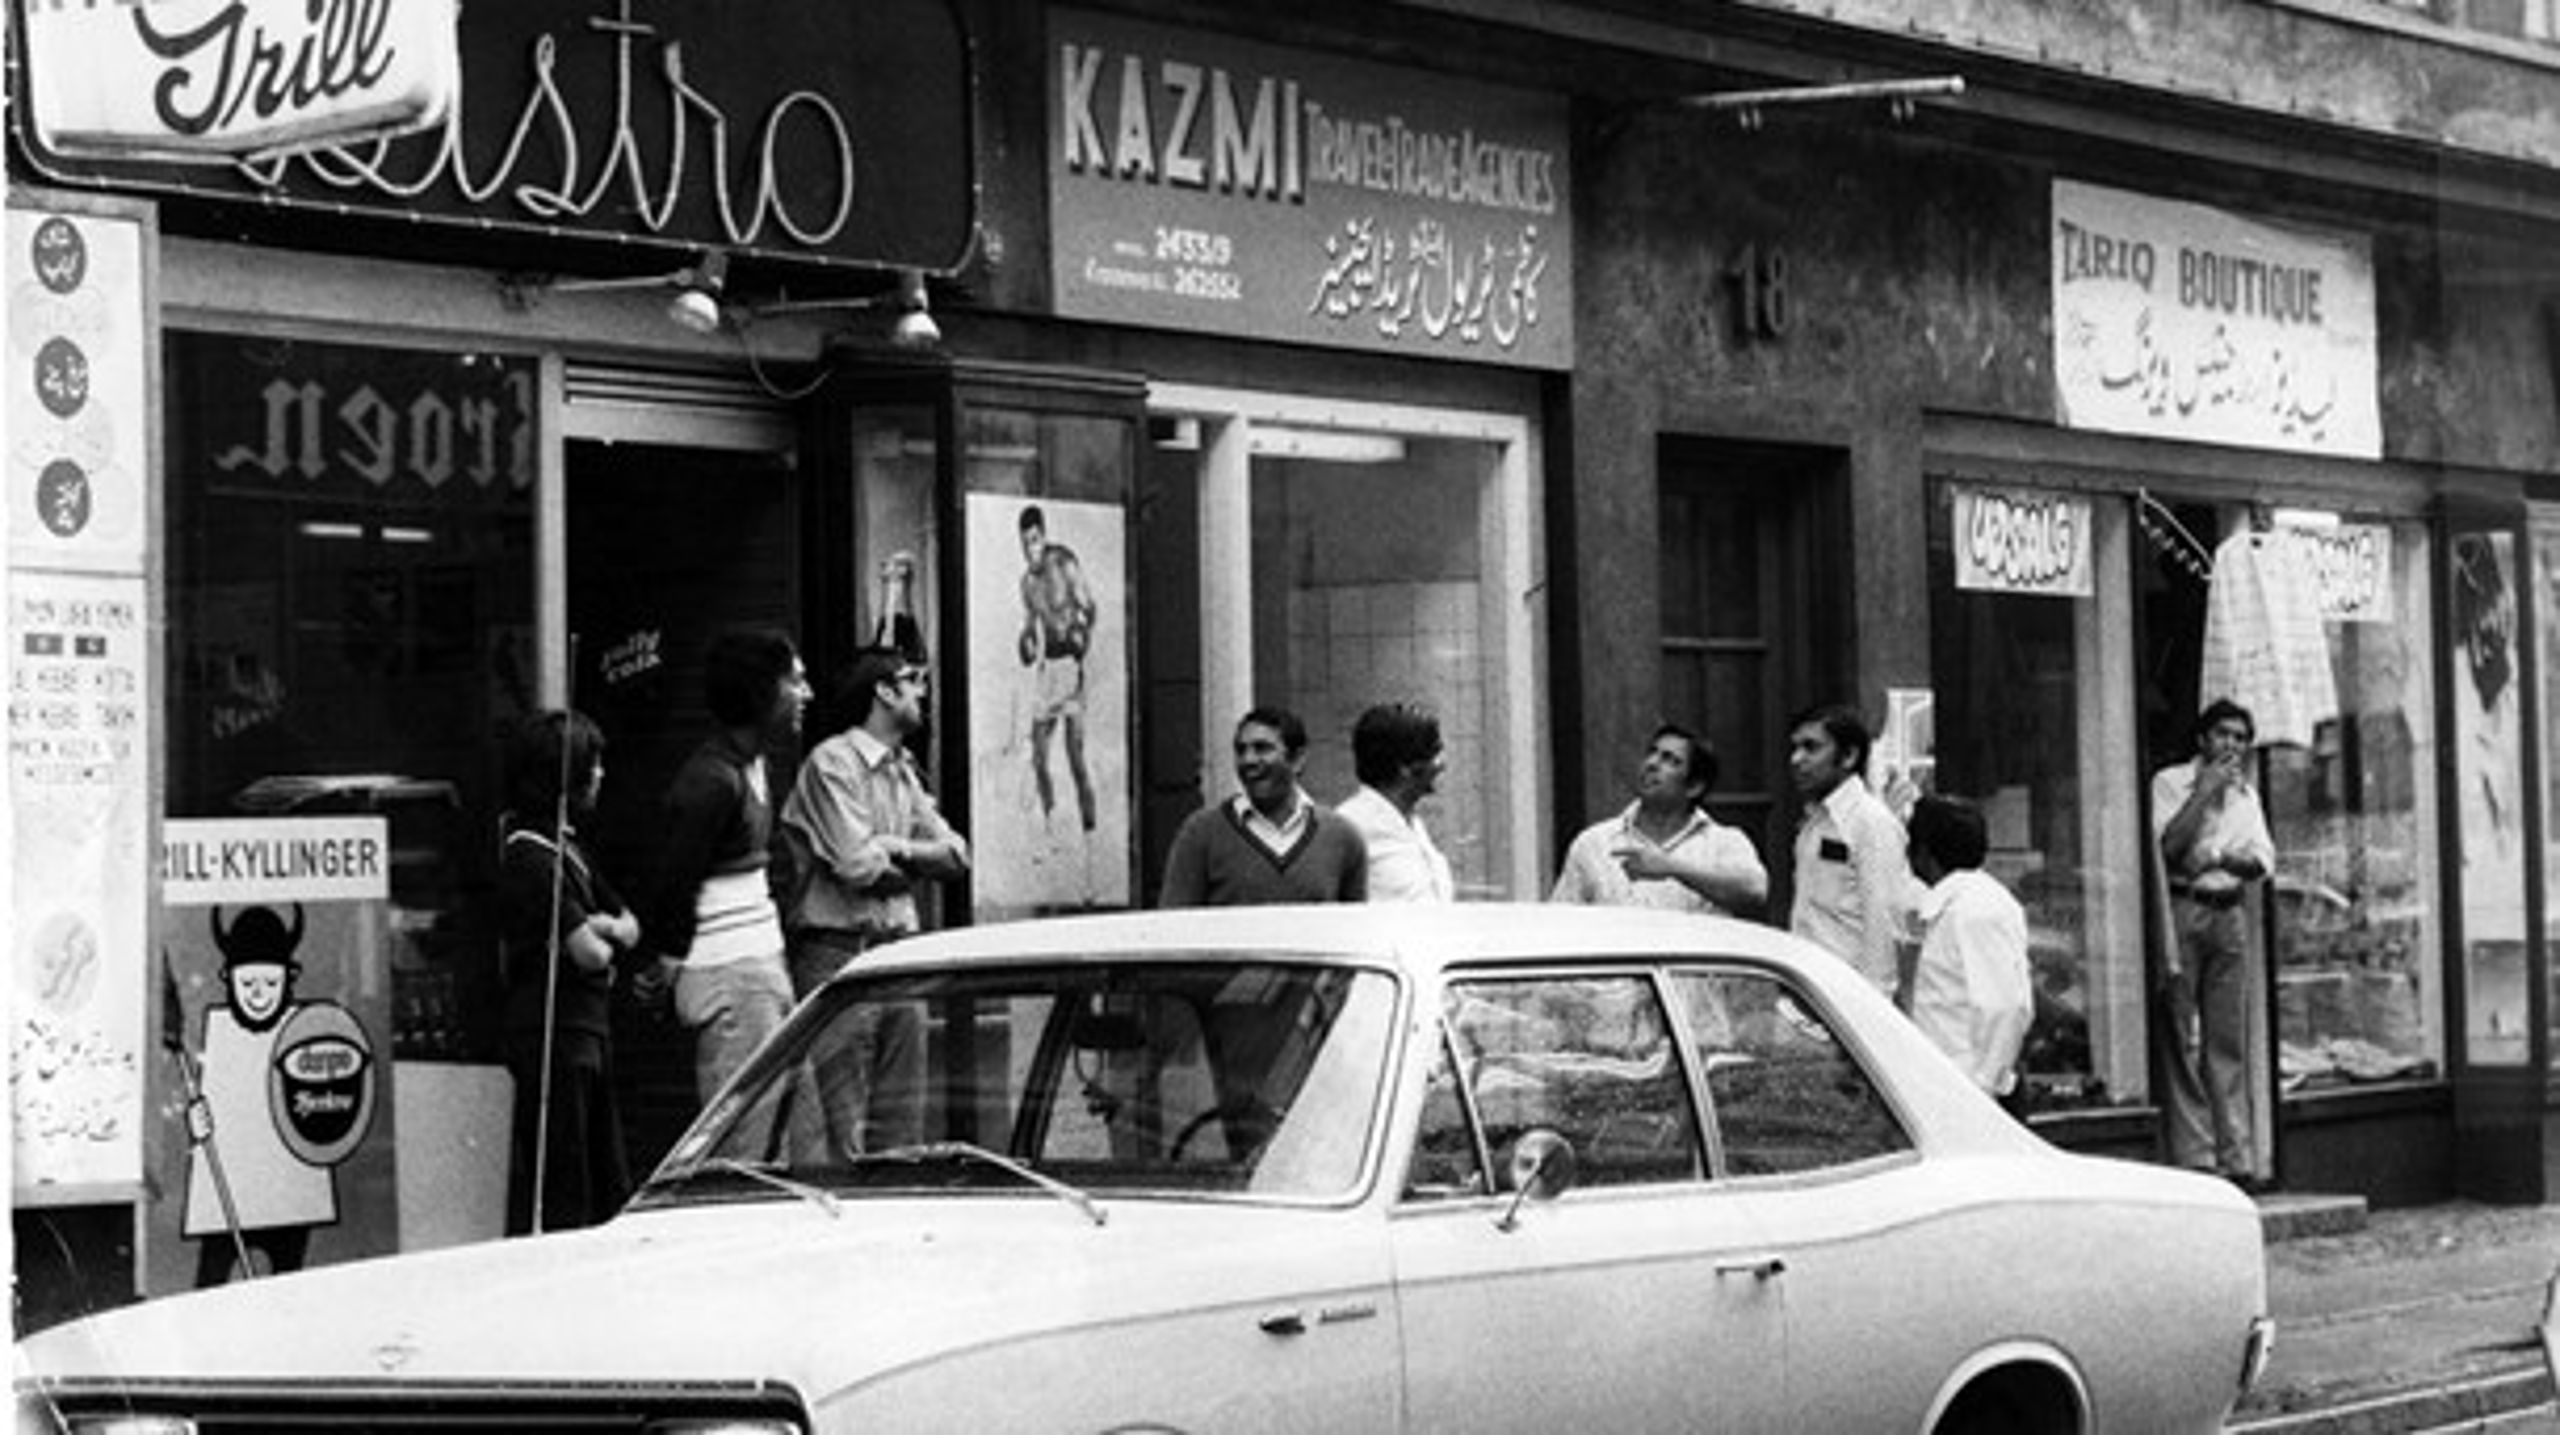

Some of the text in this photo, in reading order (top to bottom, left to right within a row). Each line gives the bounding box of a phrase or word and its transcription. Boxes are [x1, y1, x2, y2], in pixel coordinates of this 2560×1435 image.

[1062, 43, 1301, 199] KAZMI
[1462, 128, 1556, 215] AGENCIES
[1728, 242, 1791, 340] 18
[2058, 217, 2322, 326] TARIQ BOUTIQUE
[164, 839, 378, 880] ILL-KYLLINGER
